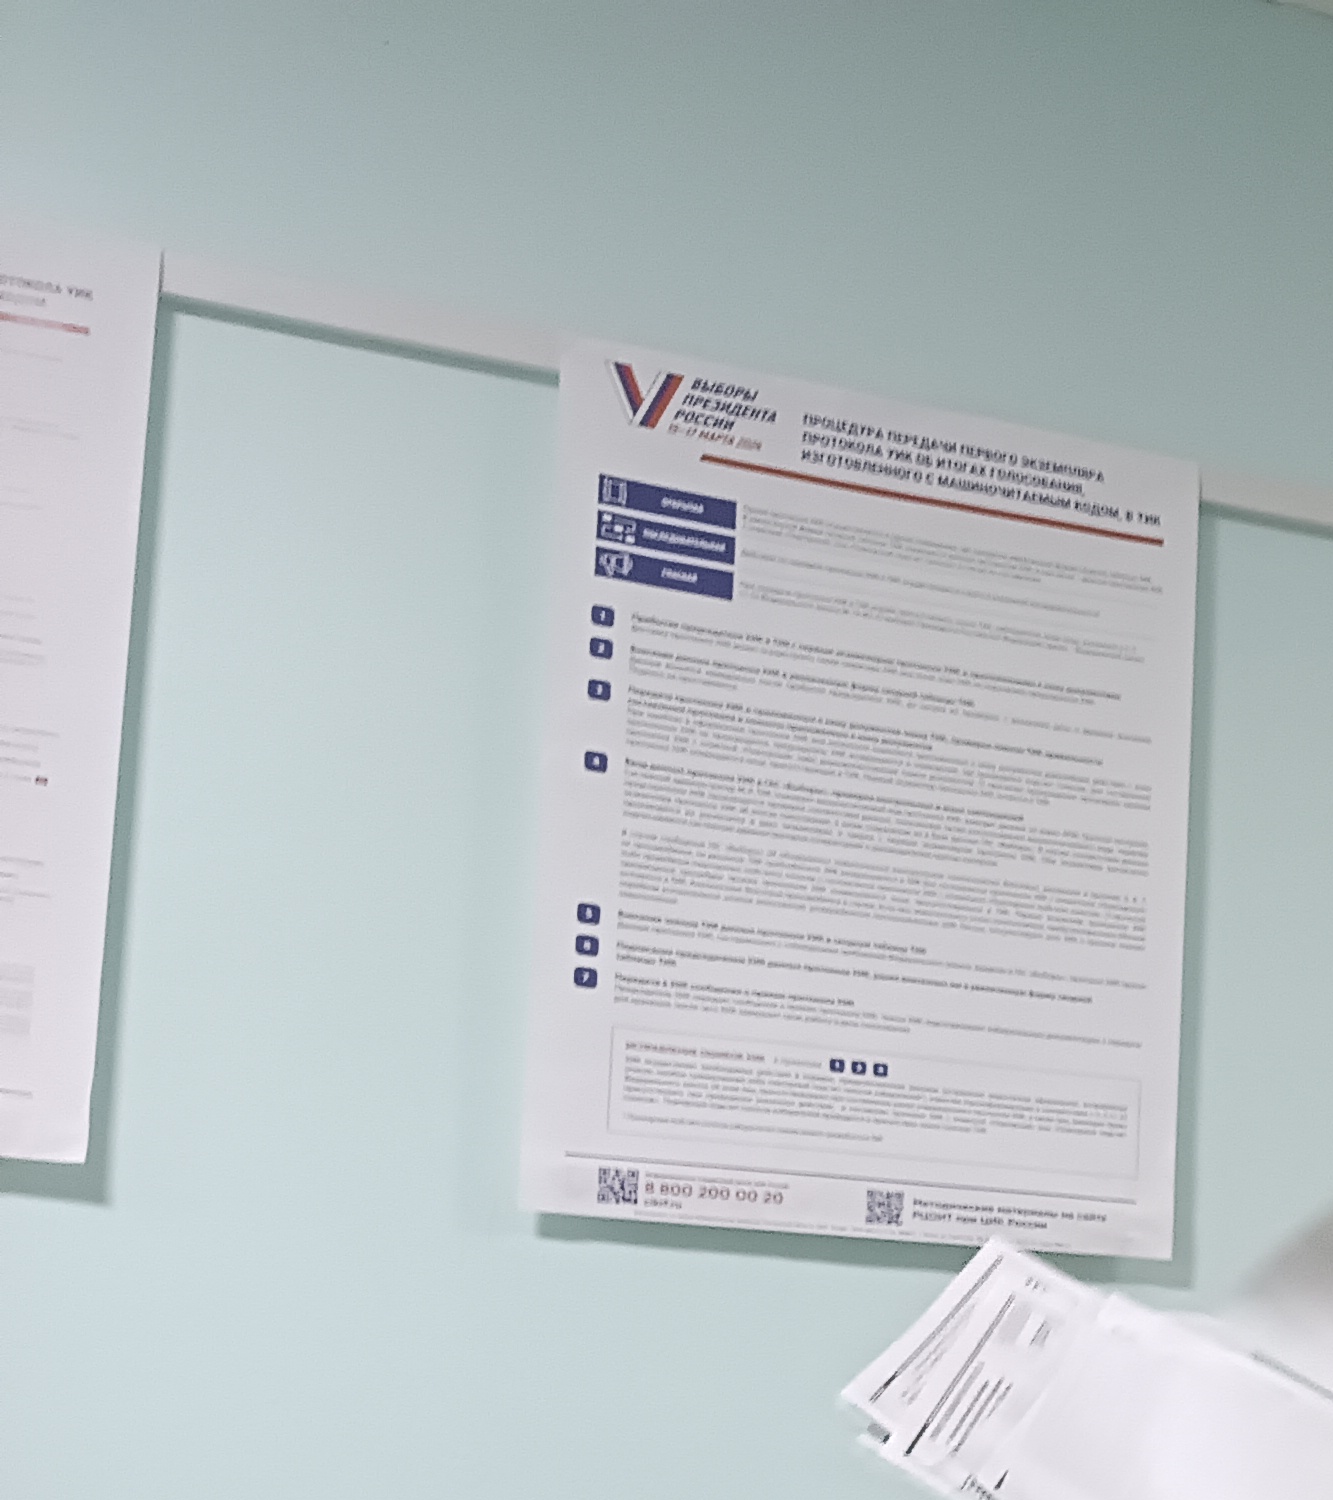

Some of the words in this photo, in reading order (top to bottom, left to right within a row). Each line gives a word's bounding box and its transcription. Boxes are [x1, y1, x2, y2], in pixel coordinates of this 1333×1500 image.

[690, 377, 759, 403] ВЫБОРЫ
[673, 408, 736, 432] РОССИИ
[682, 392, 778, 424] ПРЕЗИДЕНТА
[698, 429, 736, 447] МАРТА
[802, 412, 884, 440] ПРОЦЕДУРА
[887, 429, 957, 453] ПЕРЕДАЧИ
[959, 442, 1018, 467] ПЕРВОГО
[1021, 454, 1105, 483] ЭКЗЕМПЛЯРА
[802, 430, 884, 458] ПРОТОКОЛА
[887, 449, 913, 464] УИК
[915, 452, 934, 468] ОБ
[936, 456, 987, 478] ИТОГАХ
[800, 449, 923, 484] ИЗГОТОВЛЕННОГО
[925, 472, 935, 486] С
[937, 474, 1072, 510] МАШИНОЧИТАЕМЫМ
[1137, 512, 1162, 527] ТИК
[644, 1181, 655, 1195] 8
[660, 1182, 694, 1198] 800
[698, 1185, 731, 1201] 200
[736, 1189, 758, 1204] 00
[763, 1191, 785, 1205] 20
